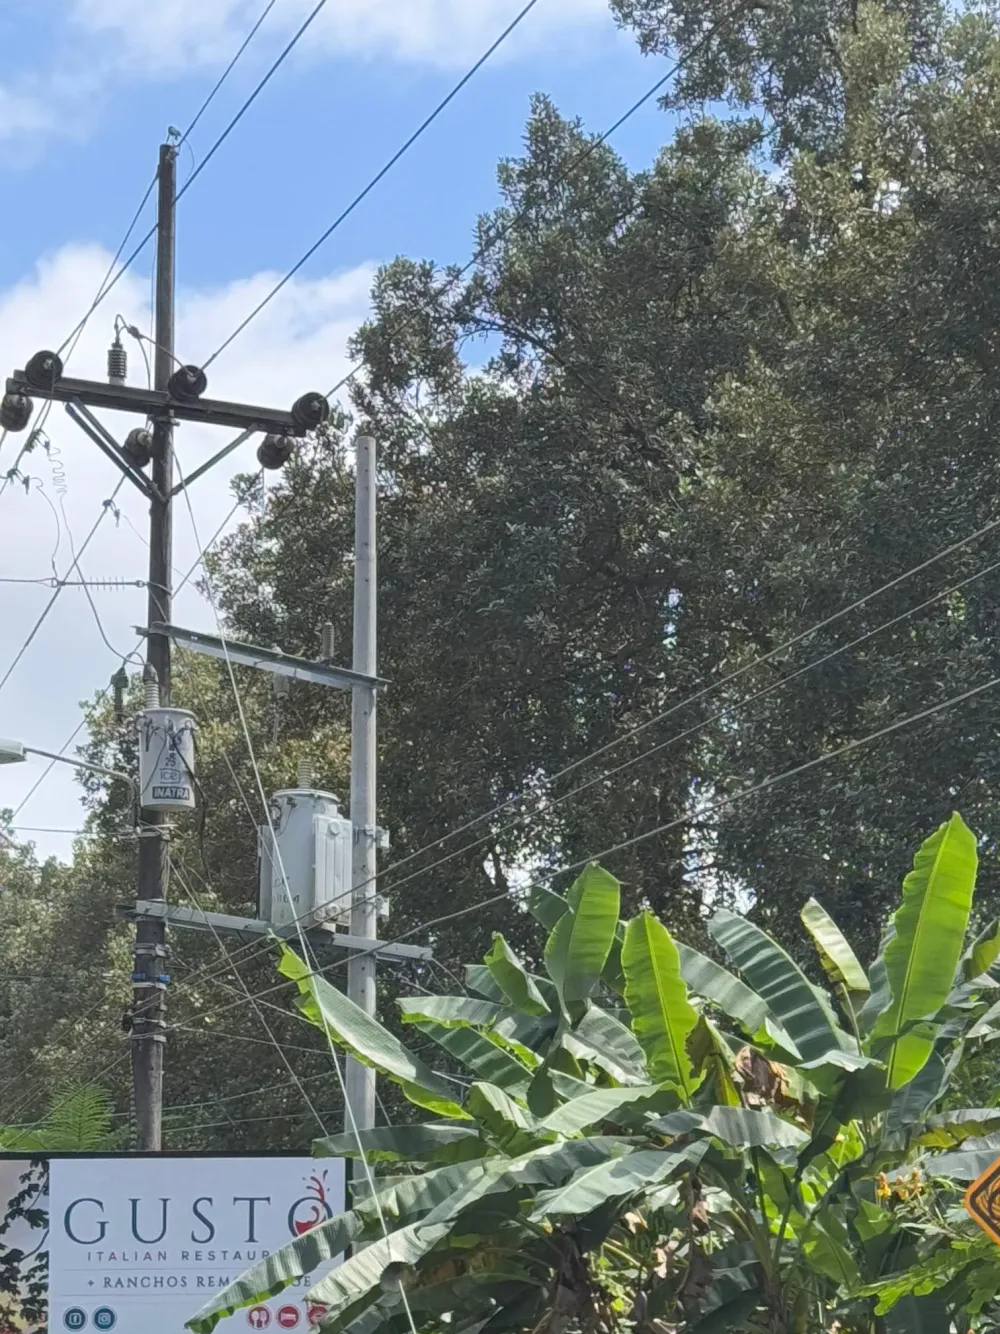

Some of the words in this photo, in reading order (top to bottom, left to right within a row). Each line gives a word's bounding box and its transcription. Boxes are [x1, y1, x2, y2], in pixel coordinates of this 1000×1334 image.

[153, 786, 189, 799] INATRA
[63, 1195, 333, 1245] GUSTO
[87, 1250, 167, 1262] ITALIAN
[181, 1250, 271, 1262] RESTAUR
[103, 1276, 188, 1289] RANCHOS
[196, 1276, 237, 1288] REM
